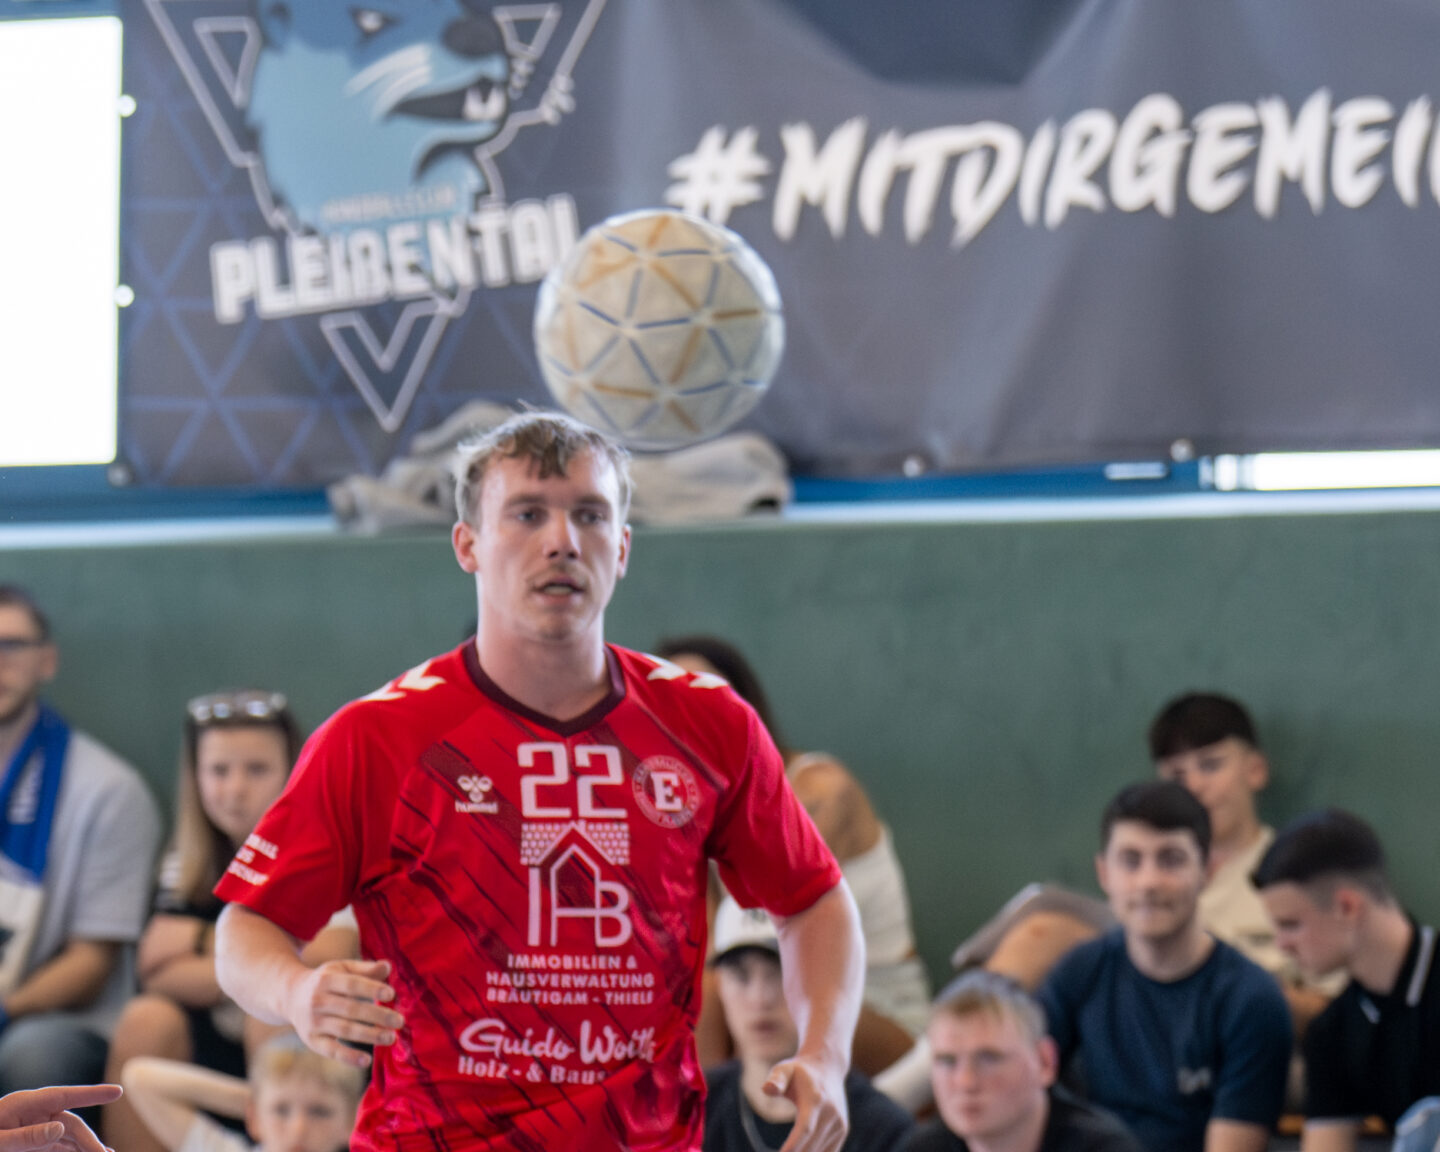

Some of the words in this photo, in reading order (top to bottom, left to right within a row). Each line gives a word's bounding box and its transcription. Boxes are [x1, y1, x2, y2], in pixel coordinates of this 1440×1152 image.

[517, 742, 627, 818] 22
[650, 772, 682, 811] E
[508, 954, 620, 970] IMMOBILIEN
[626, 955, 638, 970] &
[486, 971, 654, 989] HAUSVERWALTUNG
[459, 1017, 575, 1060] Guido
[526, 1061, 542, 1084] &
